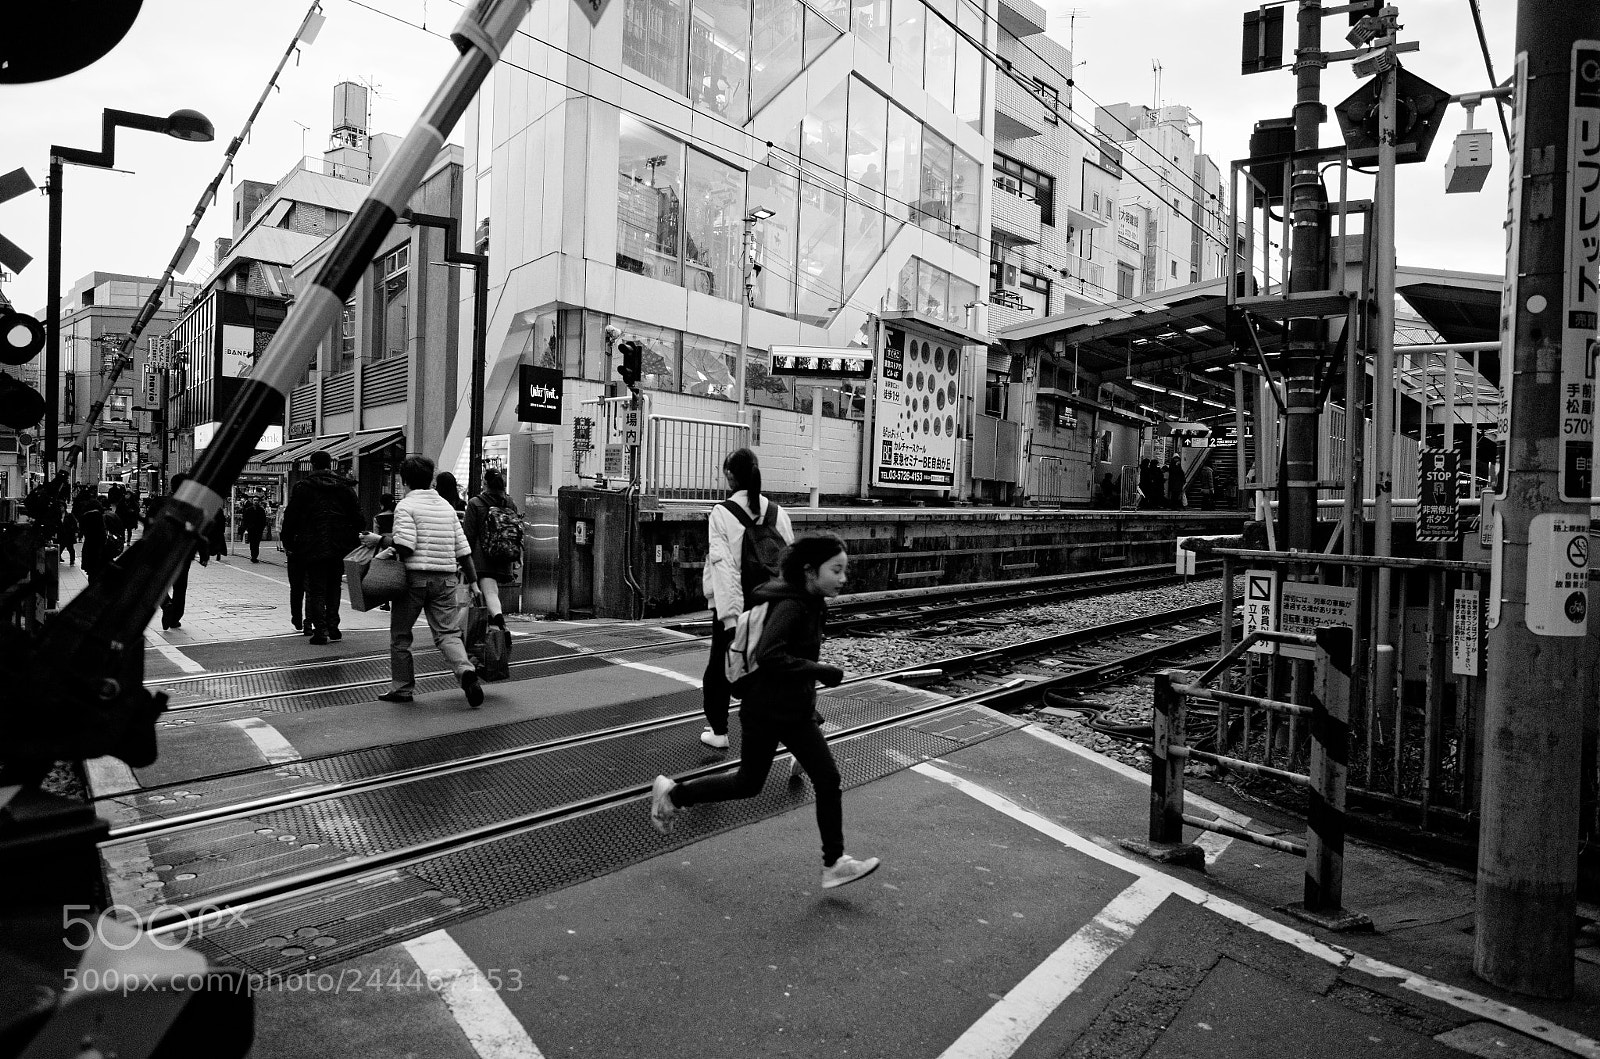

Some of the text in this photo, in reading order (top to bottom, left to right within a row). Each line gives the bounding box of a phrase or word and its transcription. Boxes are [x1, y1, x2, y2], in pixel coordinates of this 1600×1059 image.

[625, 412, 637, 443] 場内
[260, 433, 279, 443] ank
[1210, 437, 1216, 447] 2
[894, 441, 927, 453] カルチャースクール
[893, 452, 951, 470] 東急セミナーBE自由が丘
[1426, 471, 1452, 481] STOP
[1422, 505, 1454, 515] 非常停止
[1426, 514, 1450, 524] ボタン
[1247, 604, 1257, 635] 立入禁
